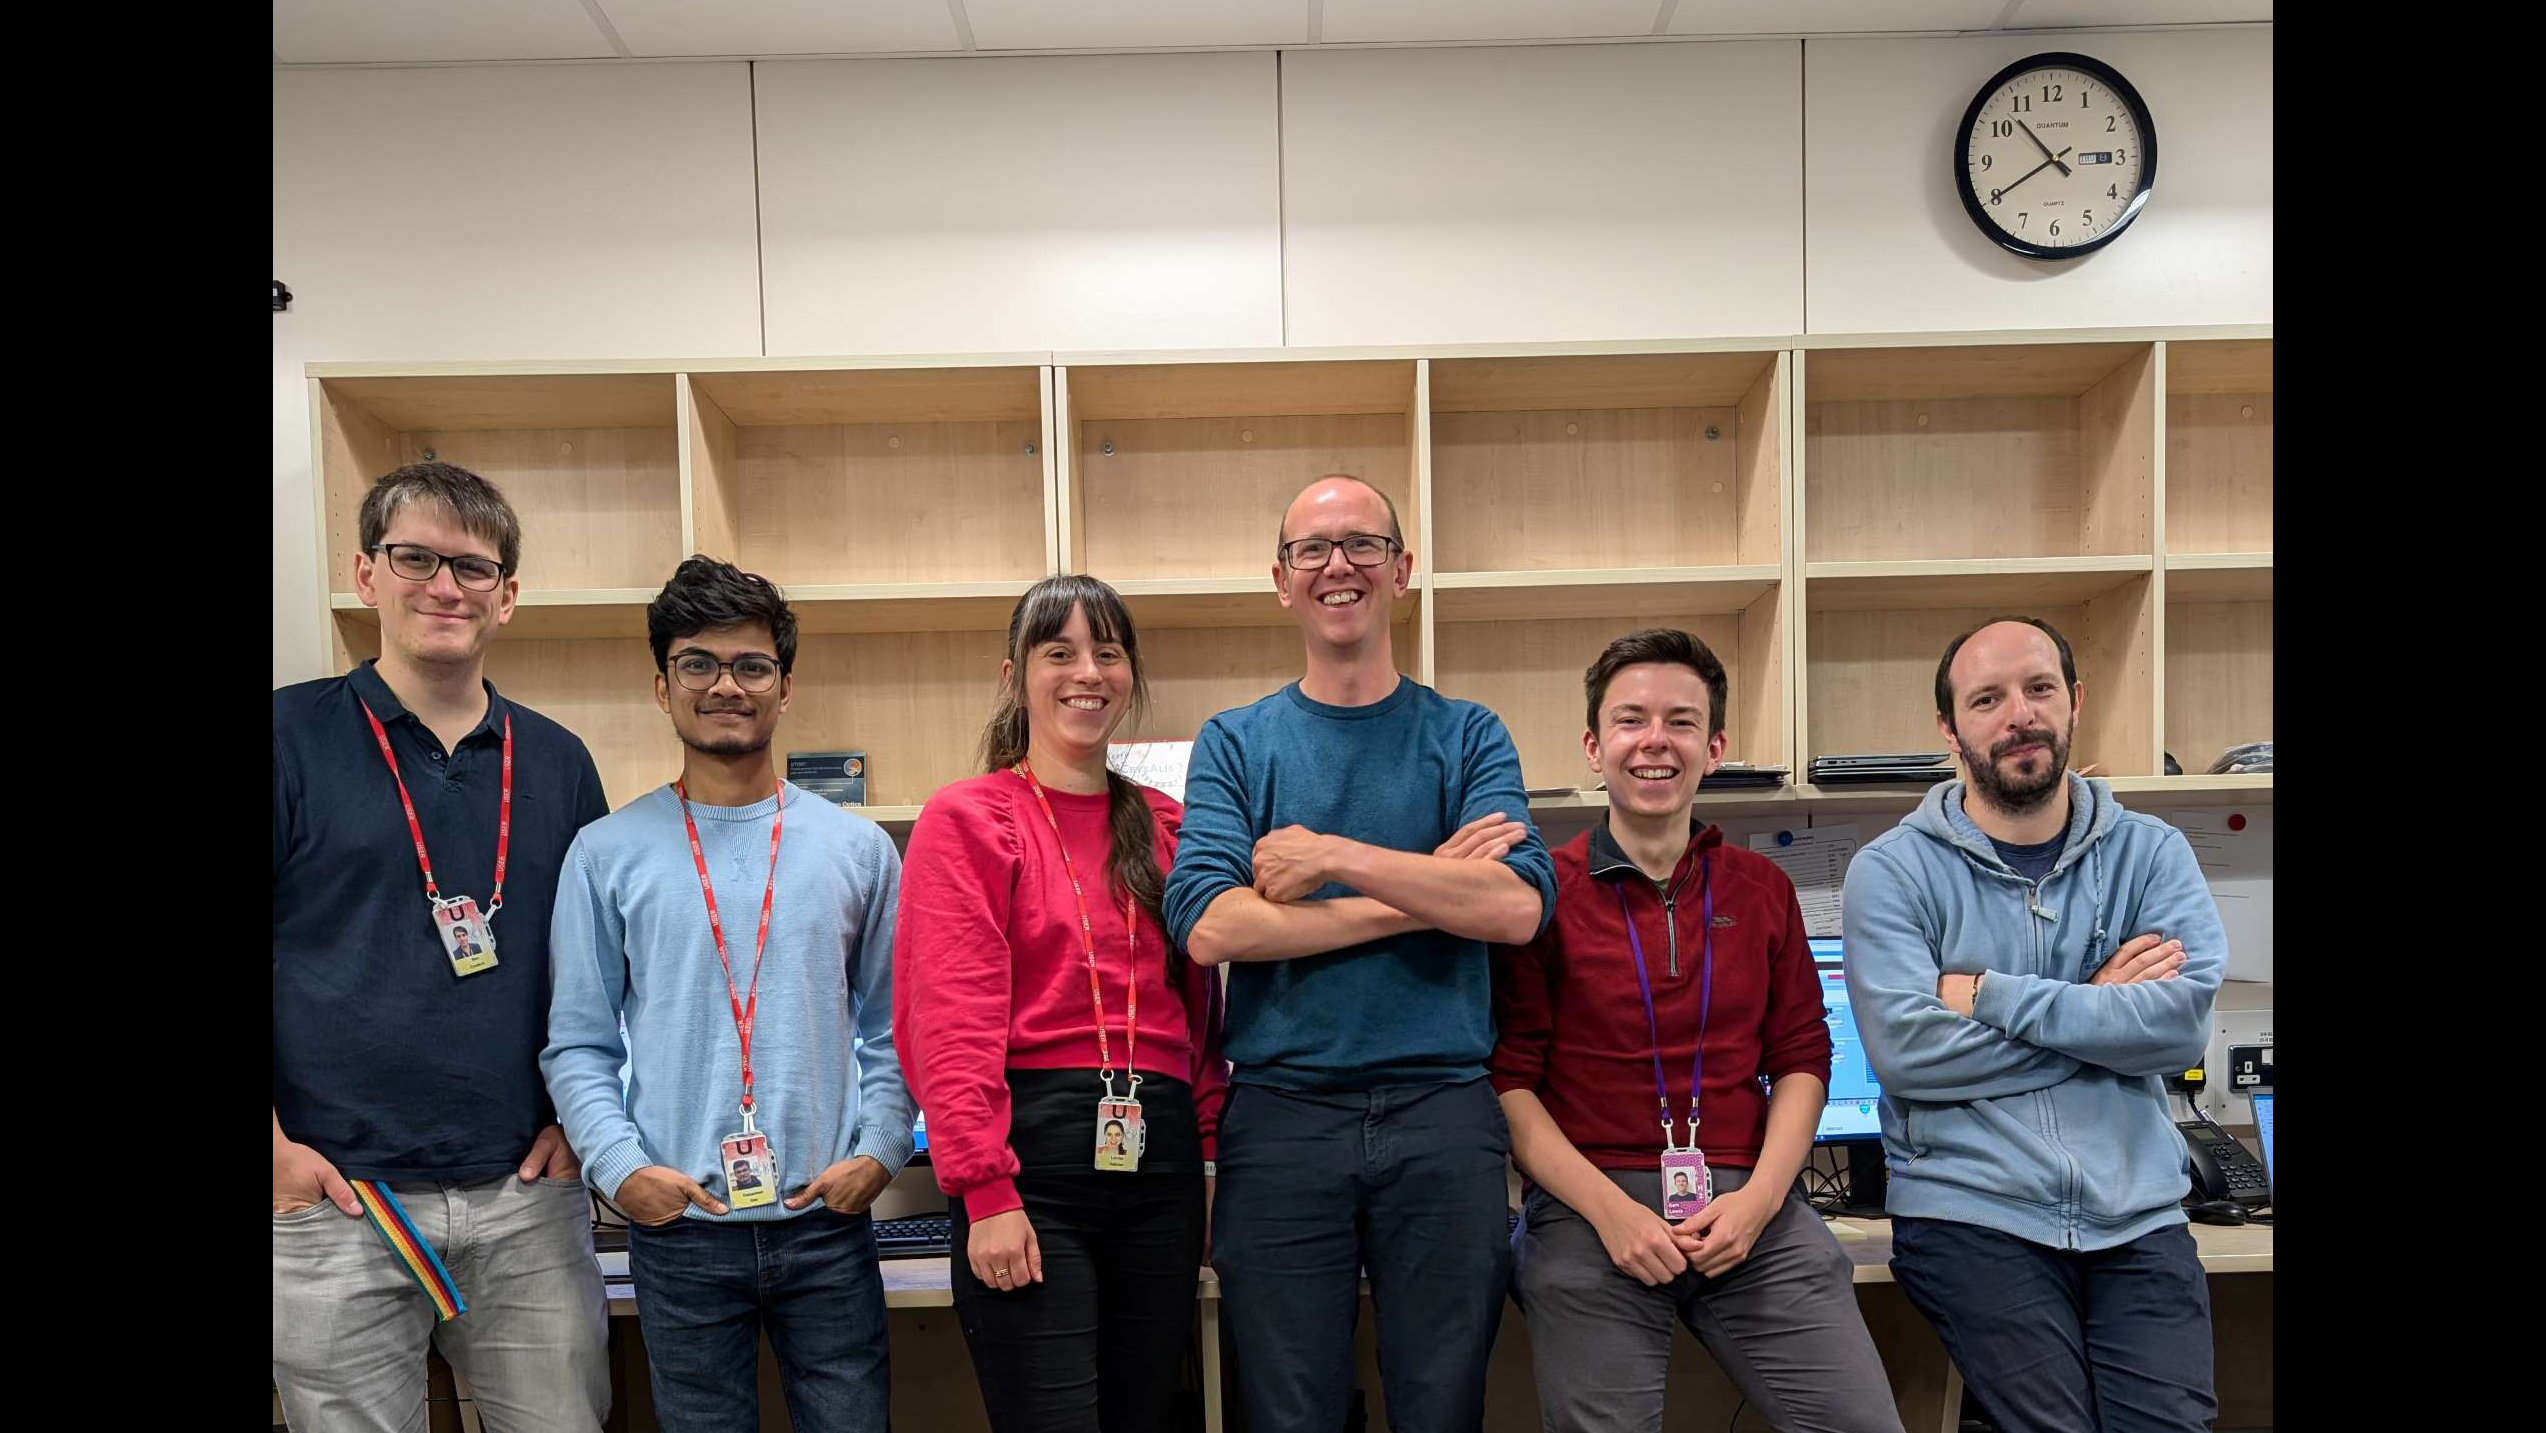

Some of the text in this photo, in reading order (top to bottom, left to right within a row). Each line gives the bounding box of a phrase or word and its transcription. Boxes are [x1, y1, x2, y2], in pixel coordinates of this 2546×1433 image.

[2042, 85, 2063, 102] 12
[2081, 92, 2089, 109] 1
[2012, 95, 2032, 112] 11
[1991, 120, 2012, 138] 10
[2105, 116, 2116, 133] 2
[1981, 154, 1993, 172] 9
[2115, 149, 2126, 166] 3
[1990, 188, 2002, 206] 8
[2106, 183, 2118, 200] 4
[2018, 212, 2028, 229] 7
[2082, 209, 2093, 227] 5
[2049, 219, 2060, 237] 6
